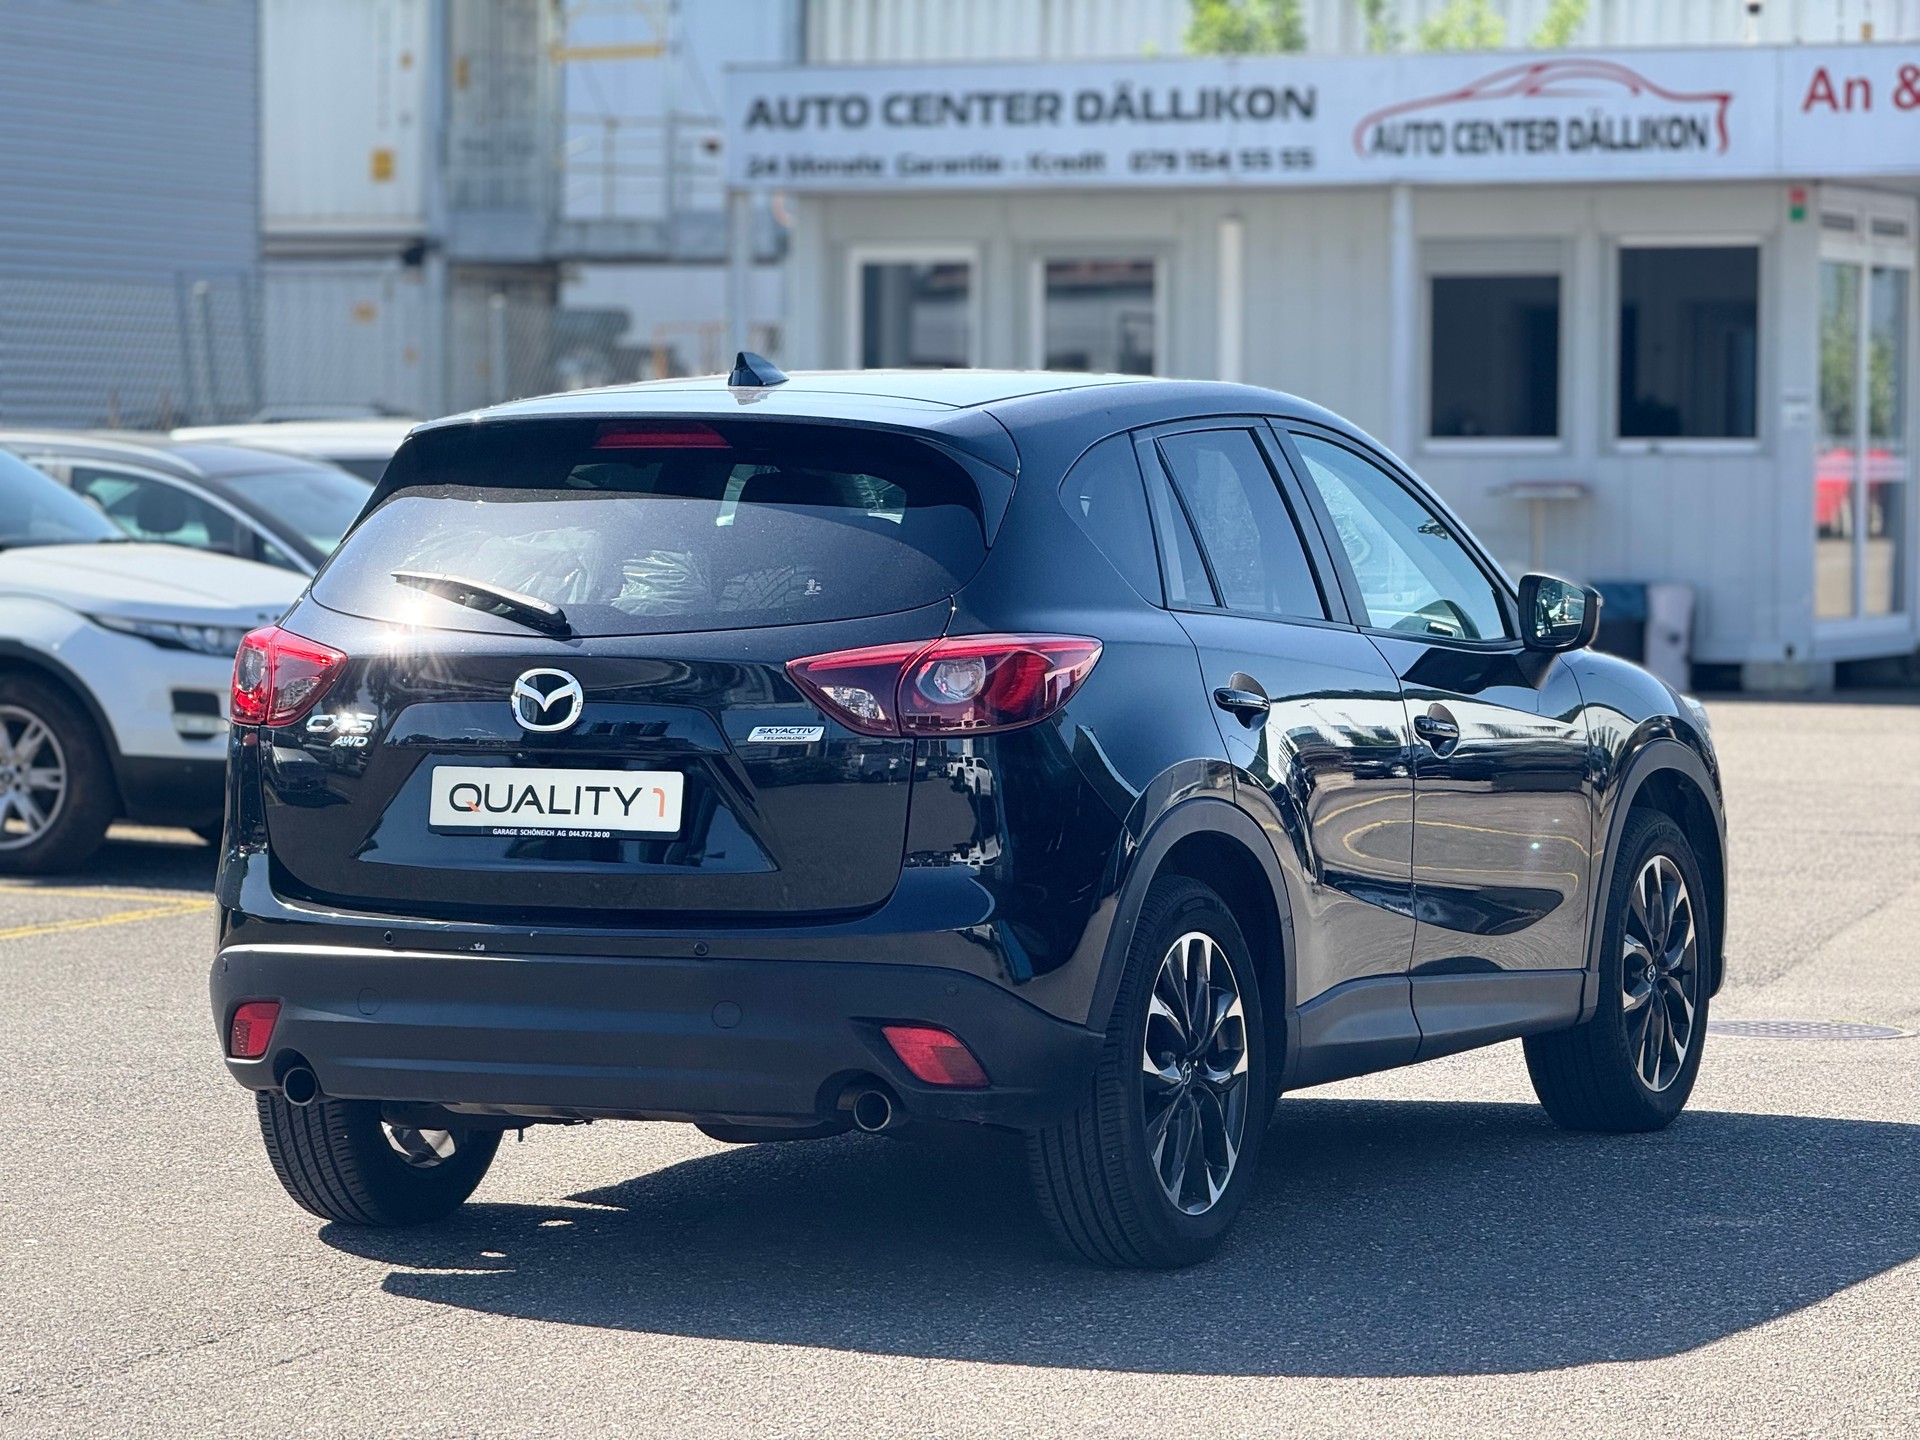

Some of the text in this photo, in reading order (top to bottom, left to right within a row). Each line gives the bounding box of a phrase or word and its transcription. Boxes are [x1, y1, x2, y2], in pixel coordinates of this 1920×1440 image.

[1801, 63, 1920, 113] An &
[745, 82, 1315, 132] AUTO CENTER DÄLLIKON
[1370, 108, 1709, 157] AUTO CENTER DÄLLIKON
[306, 712, 377, 733] CX5
[330, 735, 368, 747] AWD
[449, 783, 665, 817] QUALITY 1
[492, 828, 518, 836] GARAGE
[520, 828, 555, 837] SCHÖNEICH
[568, 830, 593, 838] 044.972
[602, 831, 611, 839] 00
